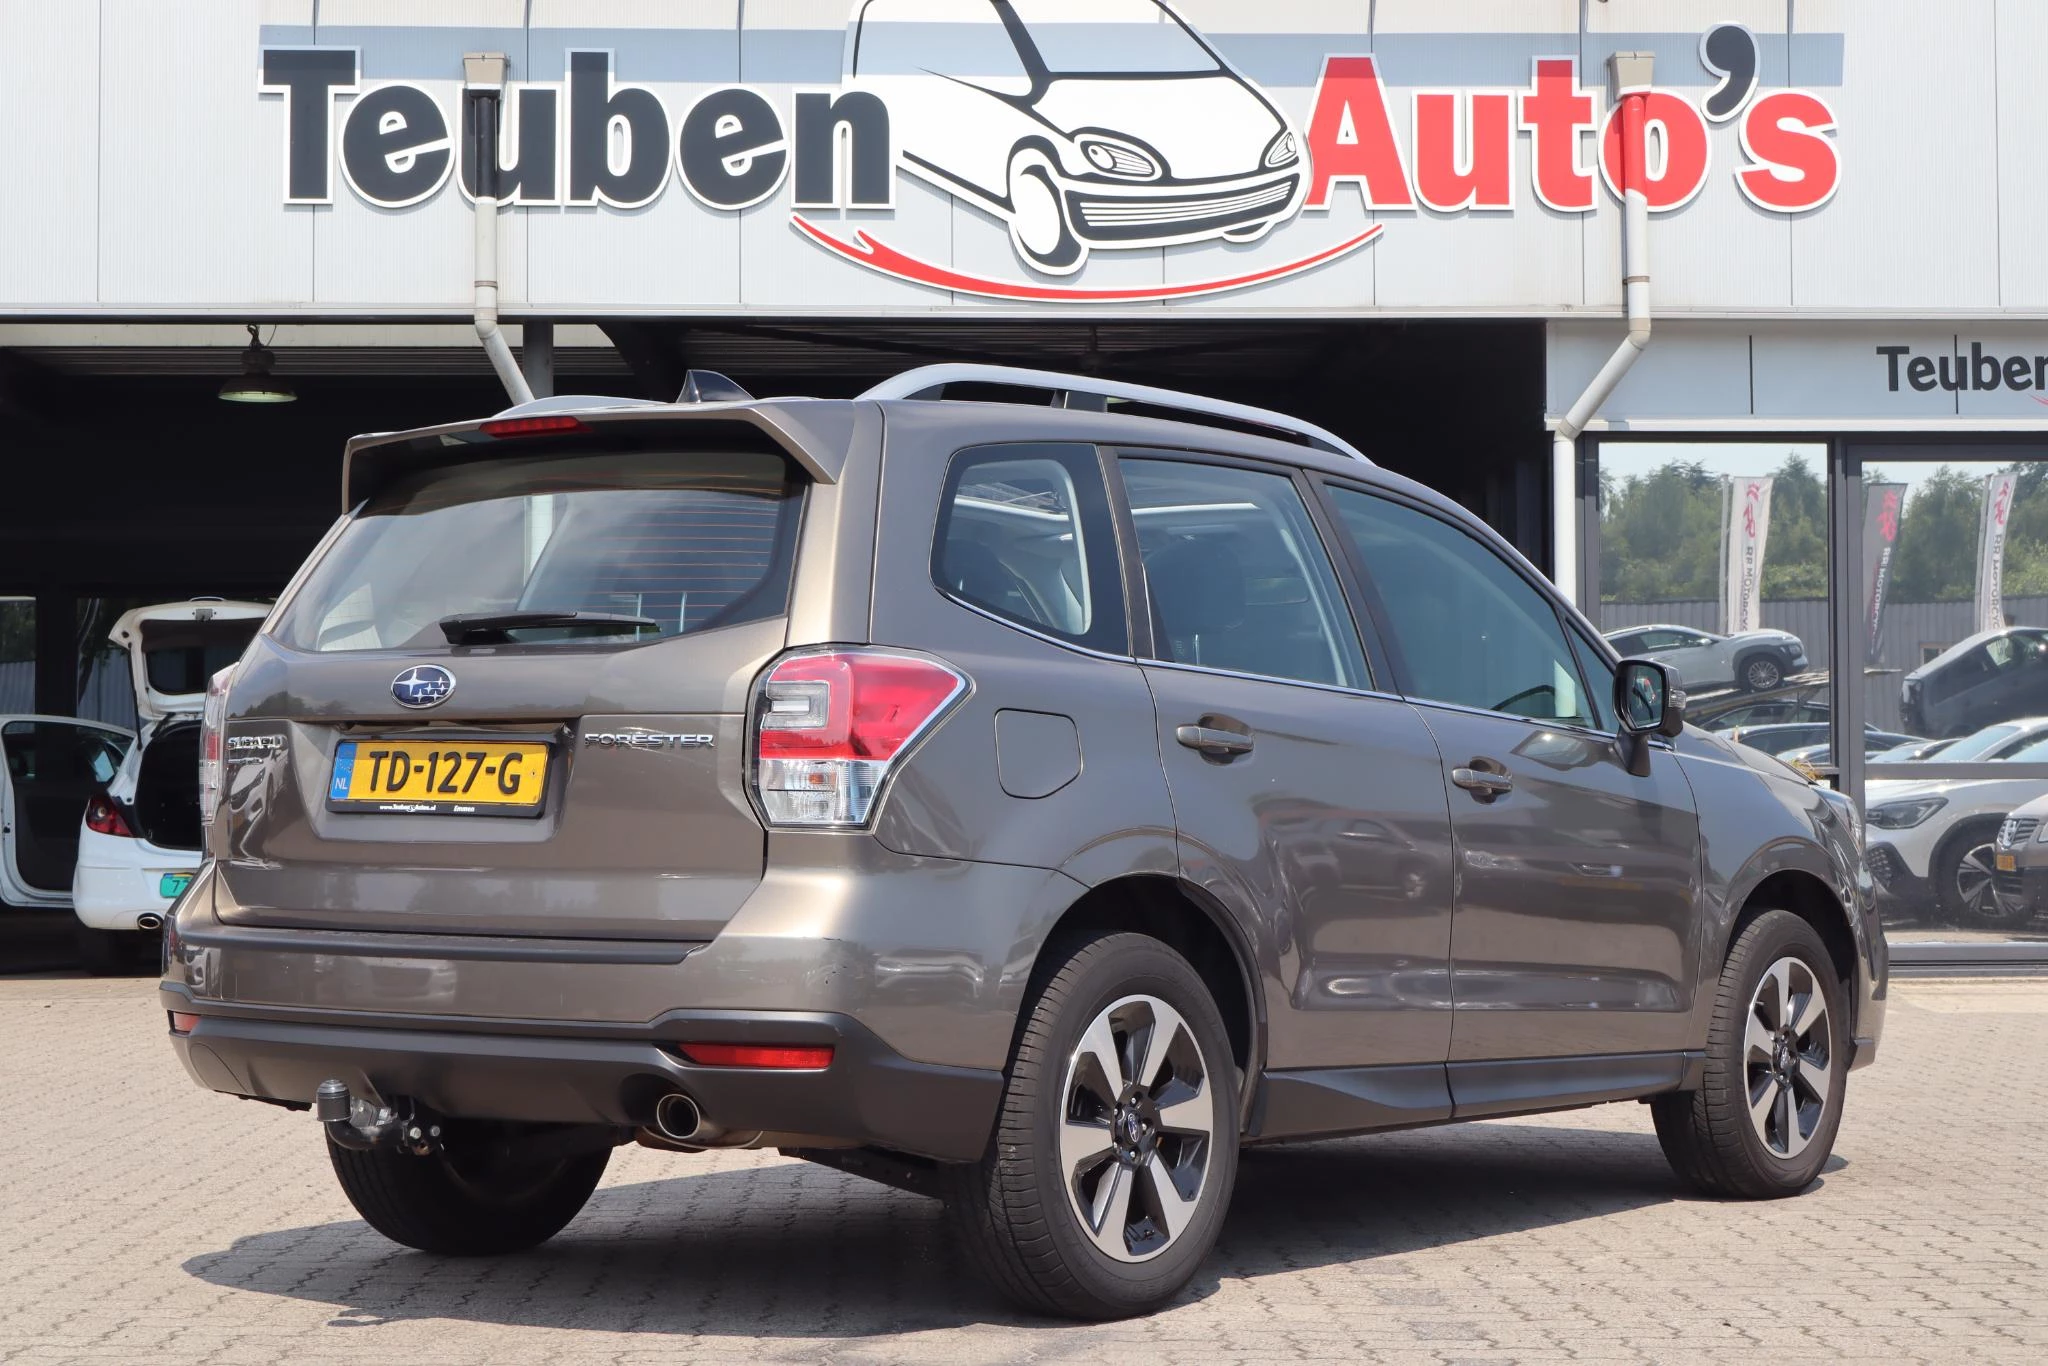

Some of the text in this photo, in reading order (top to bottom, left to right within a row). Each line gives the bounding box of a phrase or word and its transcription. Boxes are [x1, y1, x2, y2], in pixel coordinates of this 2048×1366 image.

[261, 24, 1839, 208] Teuben Auto's
[584, 733, 716, 748] FORESTER
[335, 777, 349, 790] NL
[369, 750, 523, 795] TD-127-G
